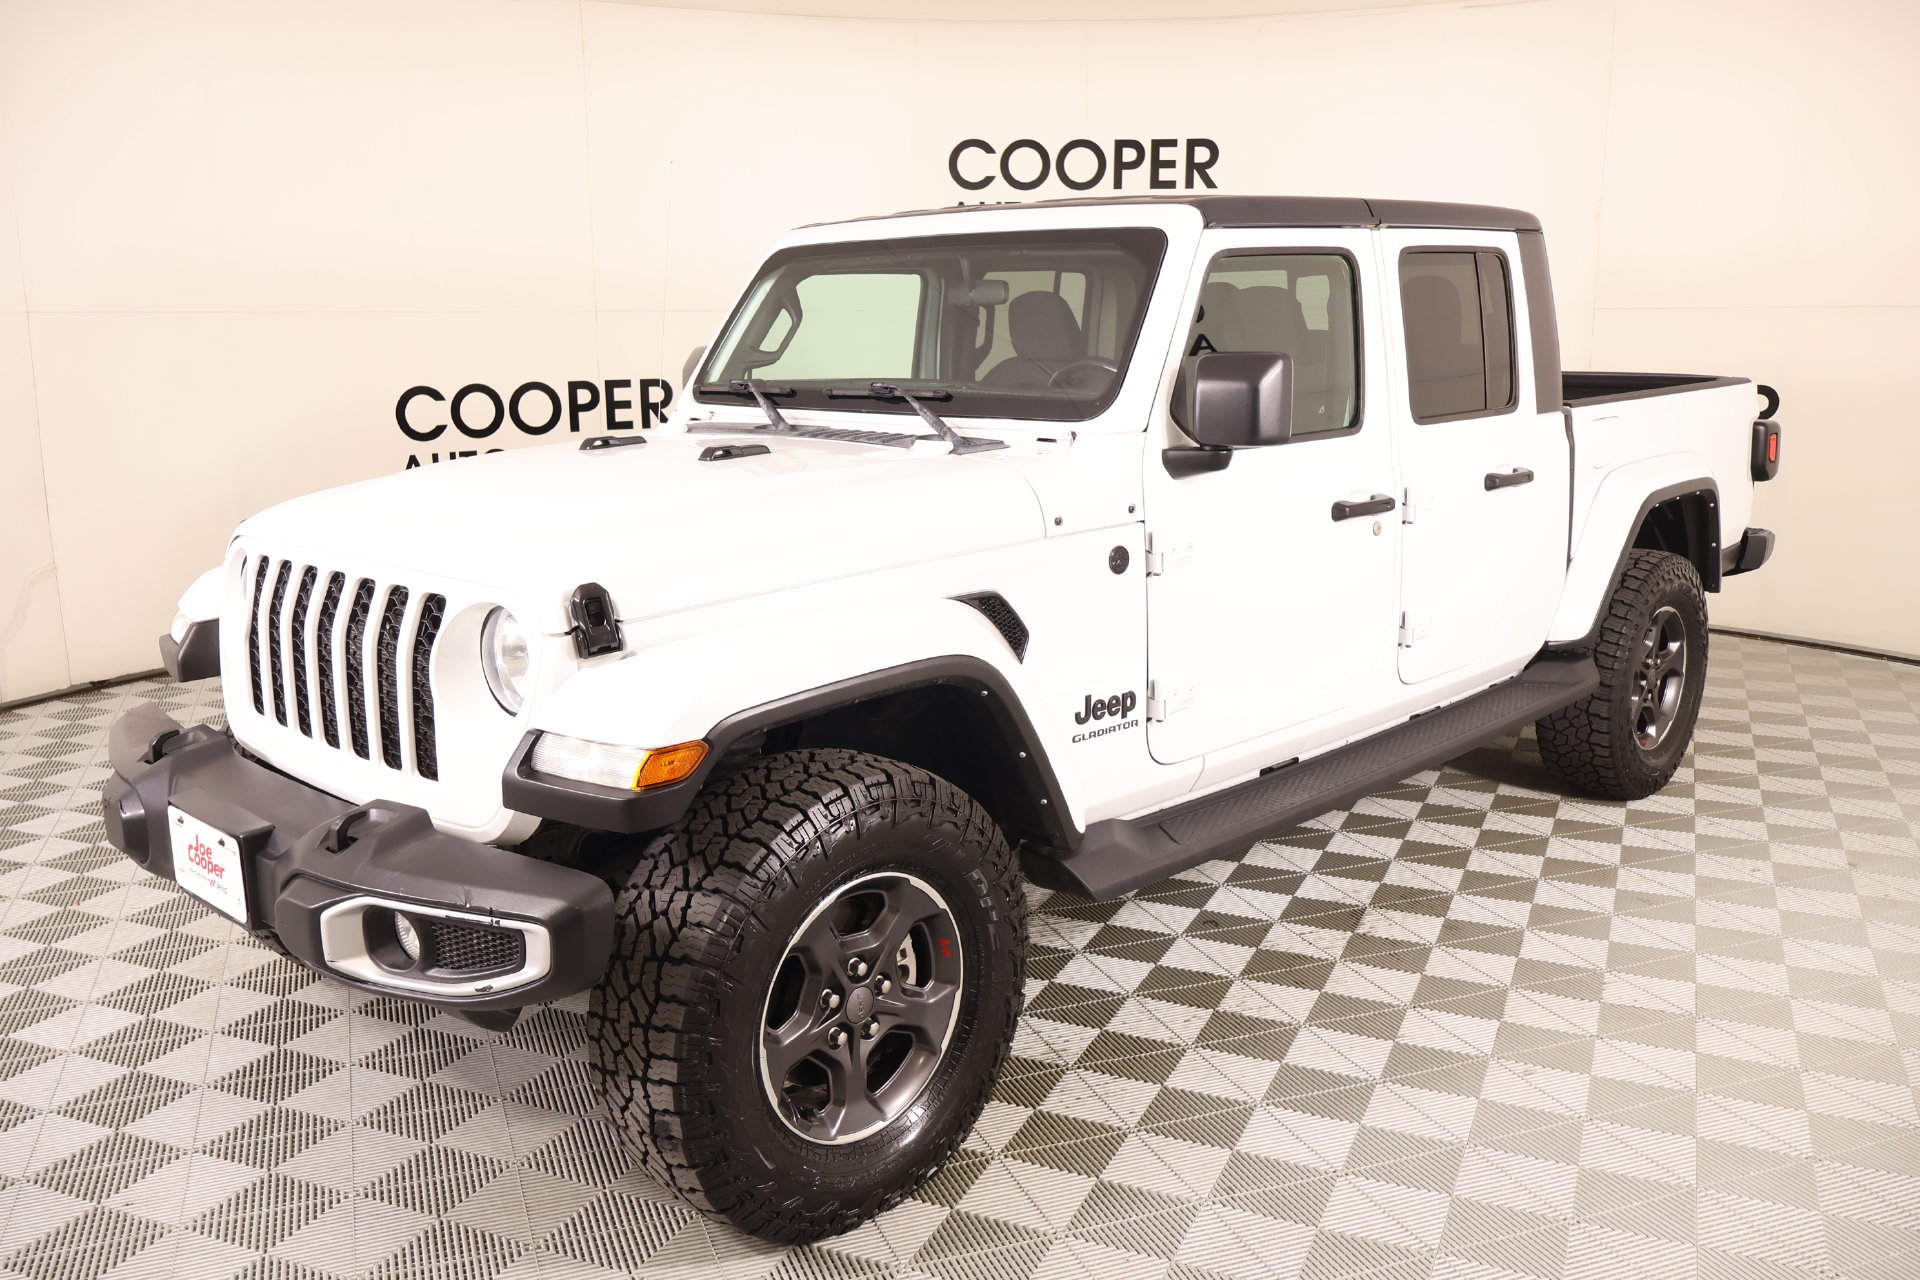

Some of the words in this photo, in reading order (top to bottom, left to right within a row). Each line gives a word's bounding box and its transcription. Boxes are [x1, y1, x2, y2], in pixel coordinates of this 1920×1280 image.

[949, 139, 1219, 191] COOPER
[395, 378, 674, 442] COOPER
[1074, 690, 1137, 725] Jeep
[1072, 719, 1139, 744] GLADIATOR
[187, 843, 226, 879] Cooper
[193, 834, 213, 860] Joe
